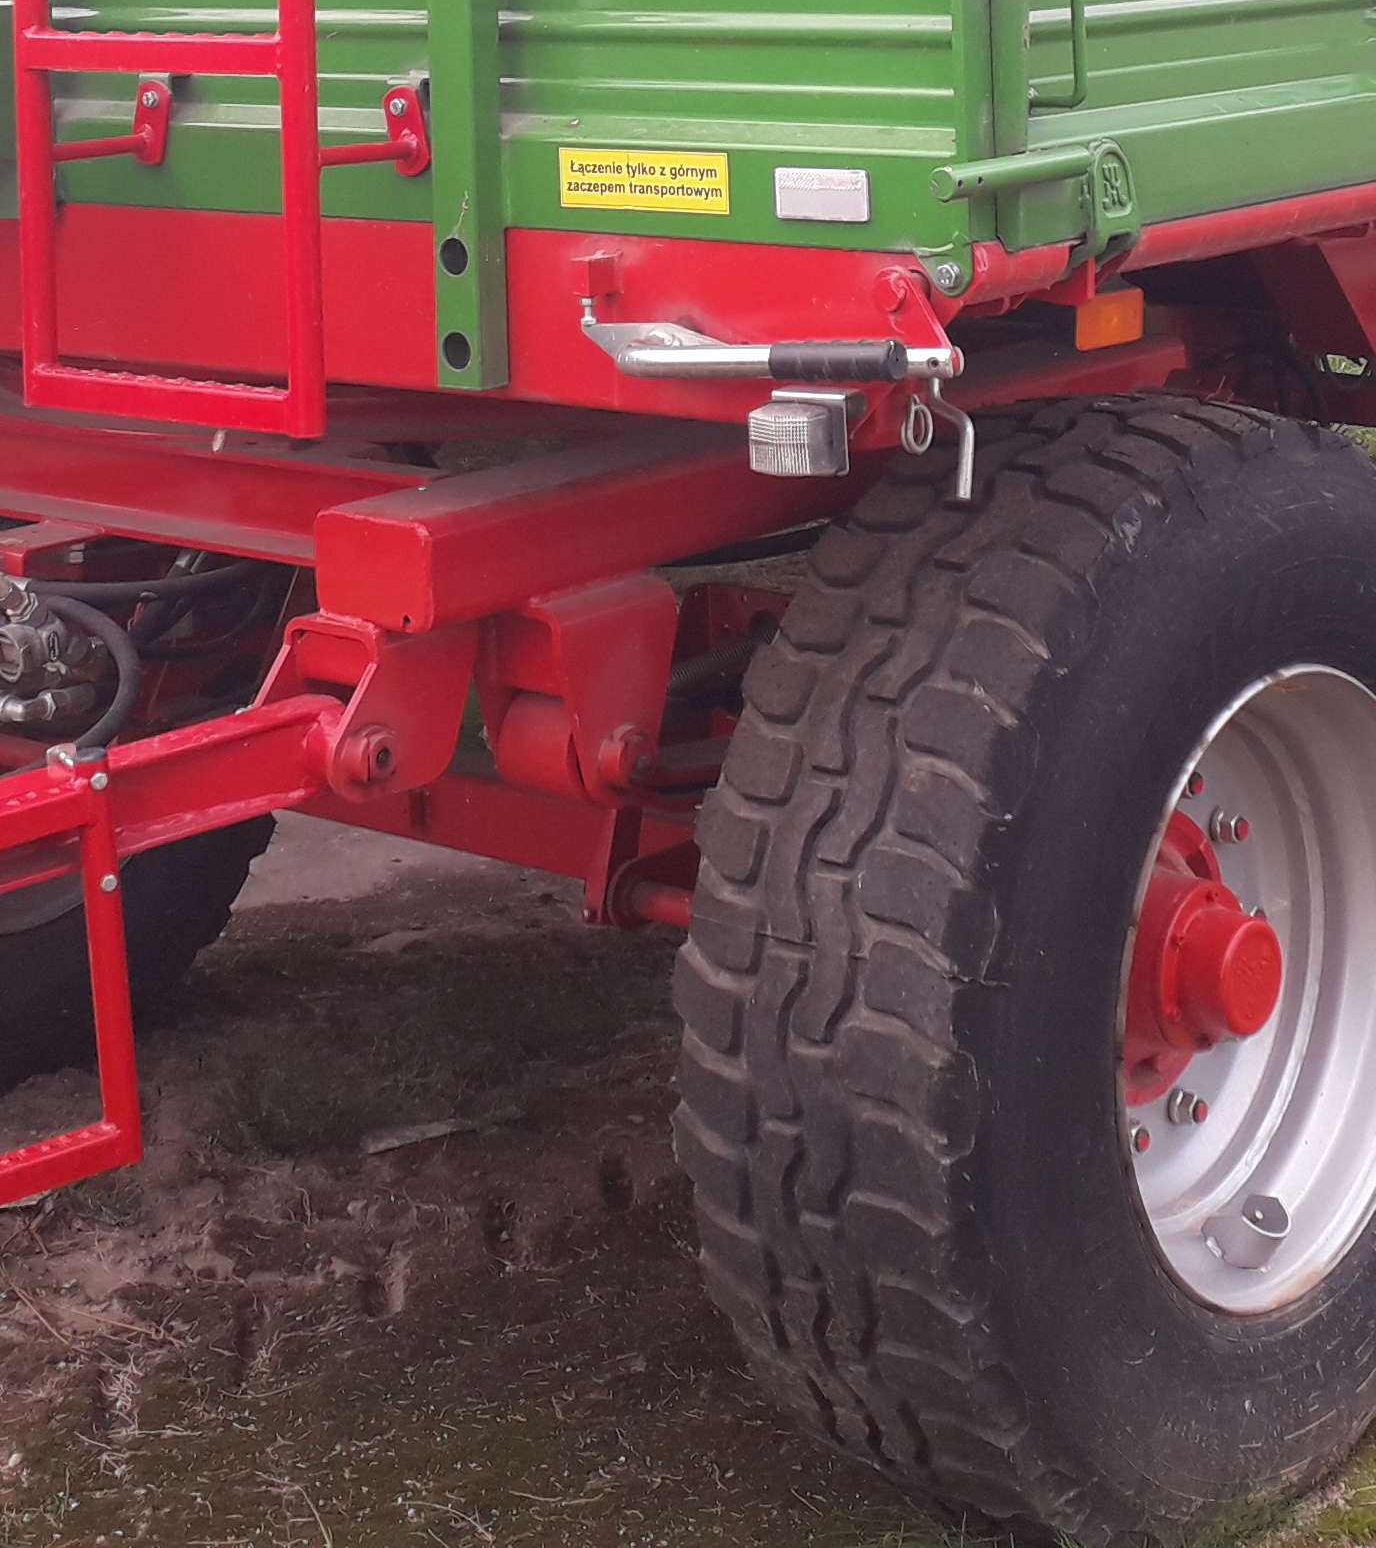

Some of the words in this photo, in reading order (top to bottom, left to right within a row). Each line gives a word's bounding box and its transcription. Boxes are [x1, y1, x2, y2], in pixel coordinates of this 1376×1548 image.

[570, 160, 623, 177] Łączenie
[626, 161, 656, 178] tylko
[659, 166, 666, 176] z
[669, 164, 717, 181] górnym
[566, 181, 626, 196] zaczepem
[629, 181, 723, 200] transportowym
